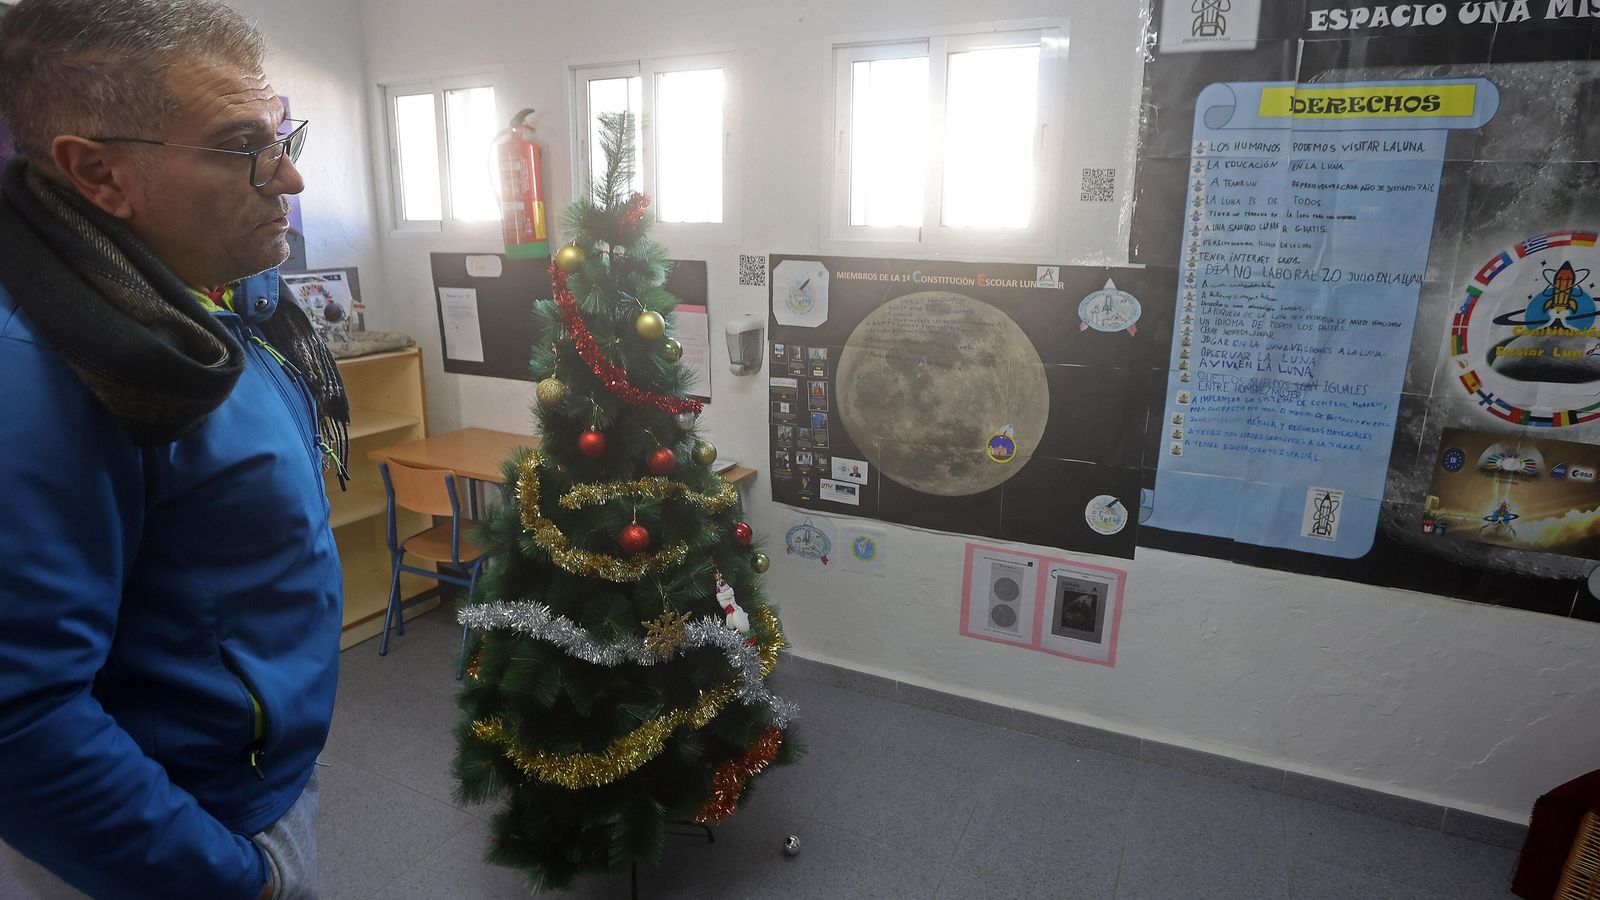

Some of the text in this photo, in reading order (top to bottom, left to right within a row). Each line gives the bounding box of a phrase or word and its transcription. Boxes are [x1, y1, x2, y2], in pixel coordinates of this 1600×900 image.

[1307, 3, 1447, 32] ESPACIO
[1457, 0, 1533, 25] UNA
[1289, 95, 1441, 114] DERECHOS
[1210, 142, 1230, 153] LOS
[1234, 141, 1281, 153] HUMANOS
[1292, 142, 1336, 153] PODEMOS
[1342, 140, 1380, 153] VISITAR
[1206, 160, 1220, 170] LA
[1225, 160, 1279, 169] EDUCACIÓN
[1210, 177, 1220, 187] A
[1205, 194, 1217, 205] LA
[1221, 196, 1241, 206] LUNA
[836, 270, 878, 282] MIEMBROS
[879, 272, 889, 282] DE
[890, 272, 901, 282] LA
[911, 270, 975, 287] CONSTITUCIÓN
[976, 272, 1018, 289] ESCOLAR
[1019, 279, 1065, 291] LUNR
[1233, 265, 1253, 280] NO
[1262, 265, 1317, 283] LABORAL
[1321, 267, 1343, 283] 20
[1214, 317, 1245, 327] IDIOMA
[1251, 320, 1263, 329] DE
[1200, 335, 1230, 347] JUGAR
[1257, 352, 1272, 362] LA
[1281, 353, 1316, 367] LUNA
[1257, 362, 1272, 372] LA
[1278, 363, 1314, 379] LUNA
[1324, 380, 1369, 396] IGUALES
